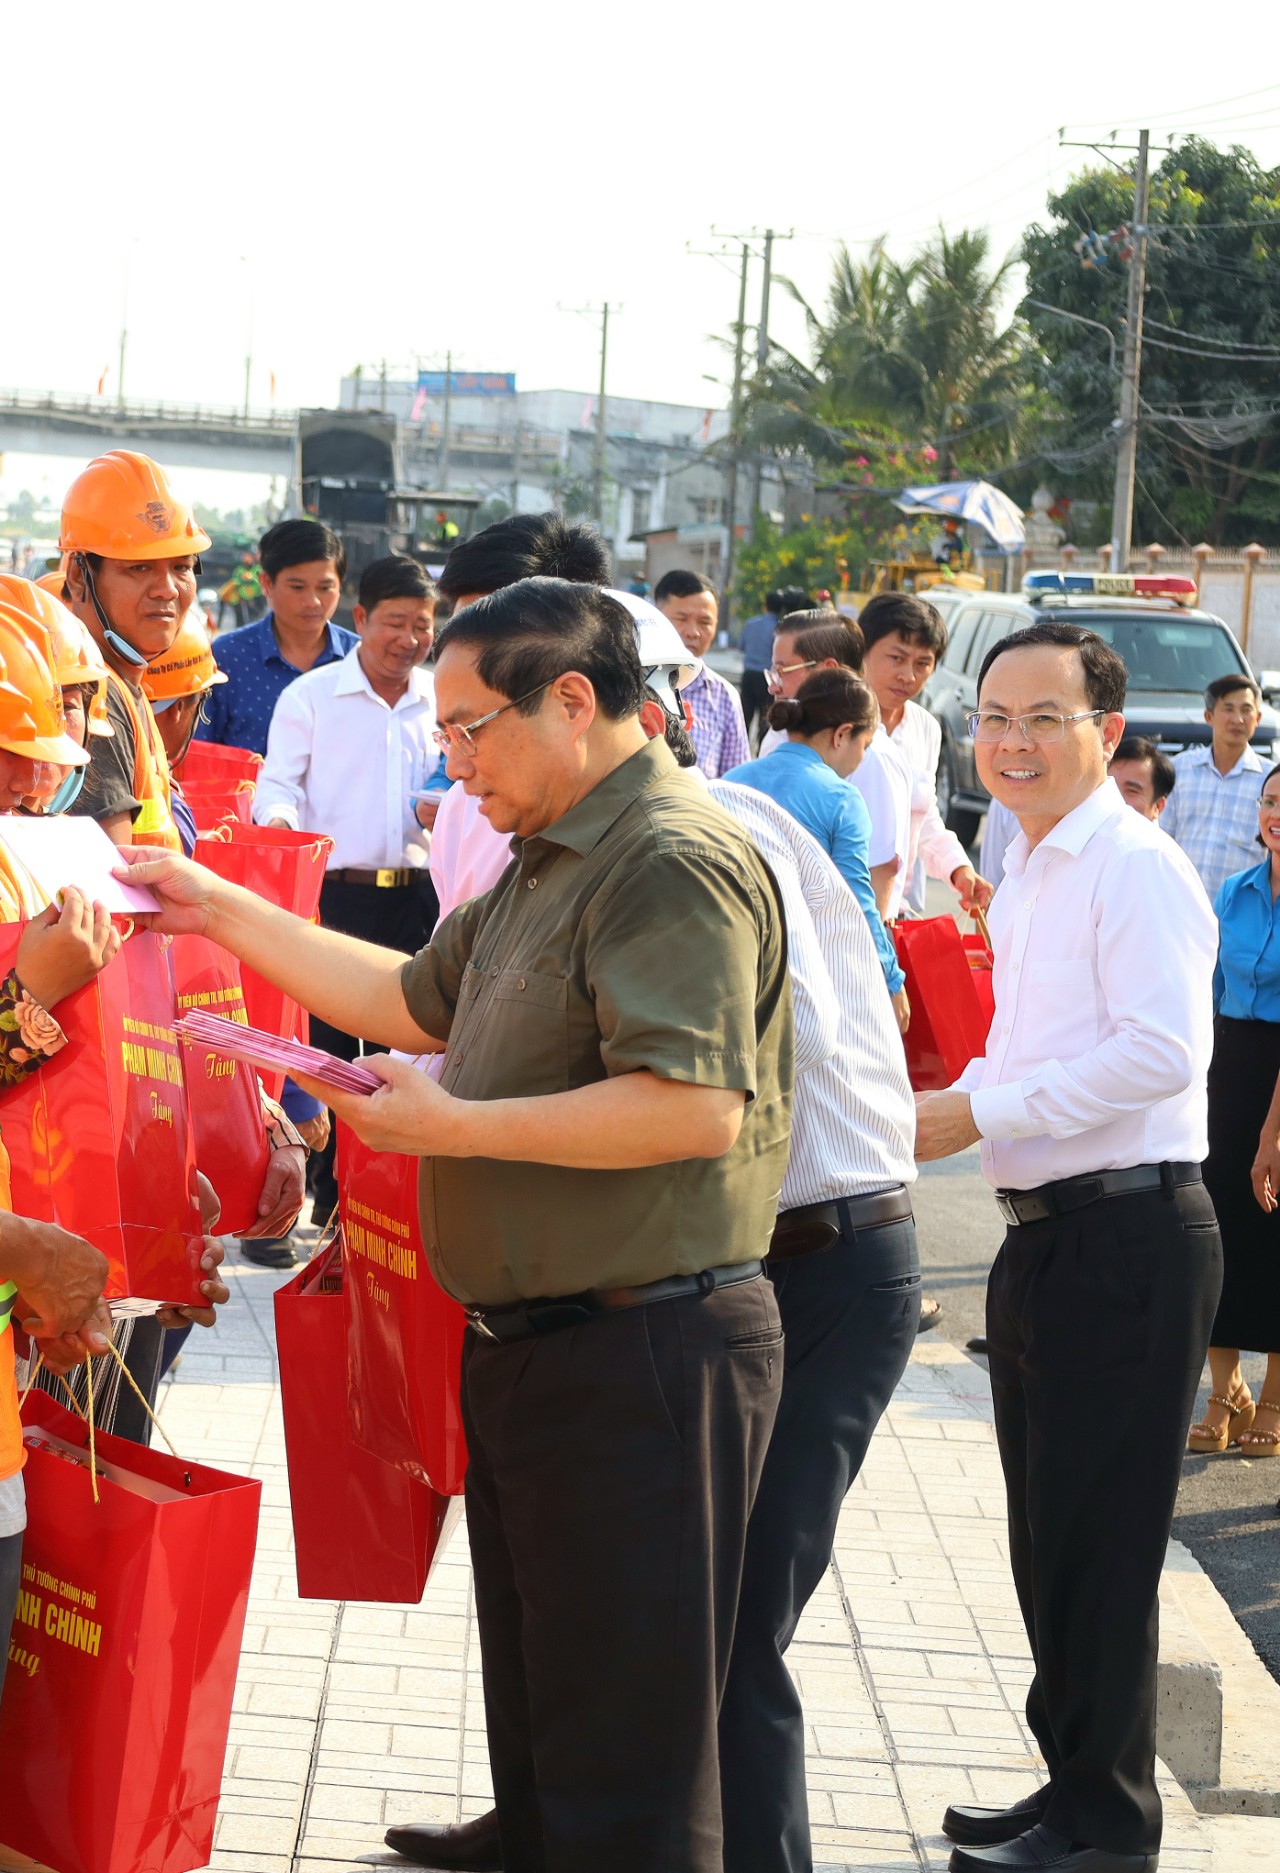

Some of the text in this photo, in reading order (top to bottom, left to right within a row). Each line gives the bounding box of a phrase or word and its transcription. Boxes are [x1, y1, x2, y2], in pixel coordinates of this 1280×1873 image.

[1098, 579, 1131, 590] POLICE
[121, 1041, 147, 1082] PHẠM
[146, 1047, 167, 1082] MINH
[346, 1218, 417, 1280] PHẠM MINH CHÍNH
[366, 1271, 390, 1312] Tặng
[23, 1563, 97, 1610] THỦ TƯỚNG CHÍNH PHỦ
[45, 1603, 102, 1657] CHÍNH
